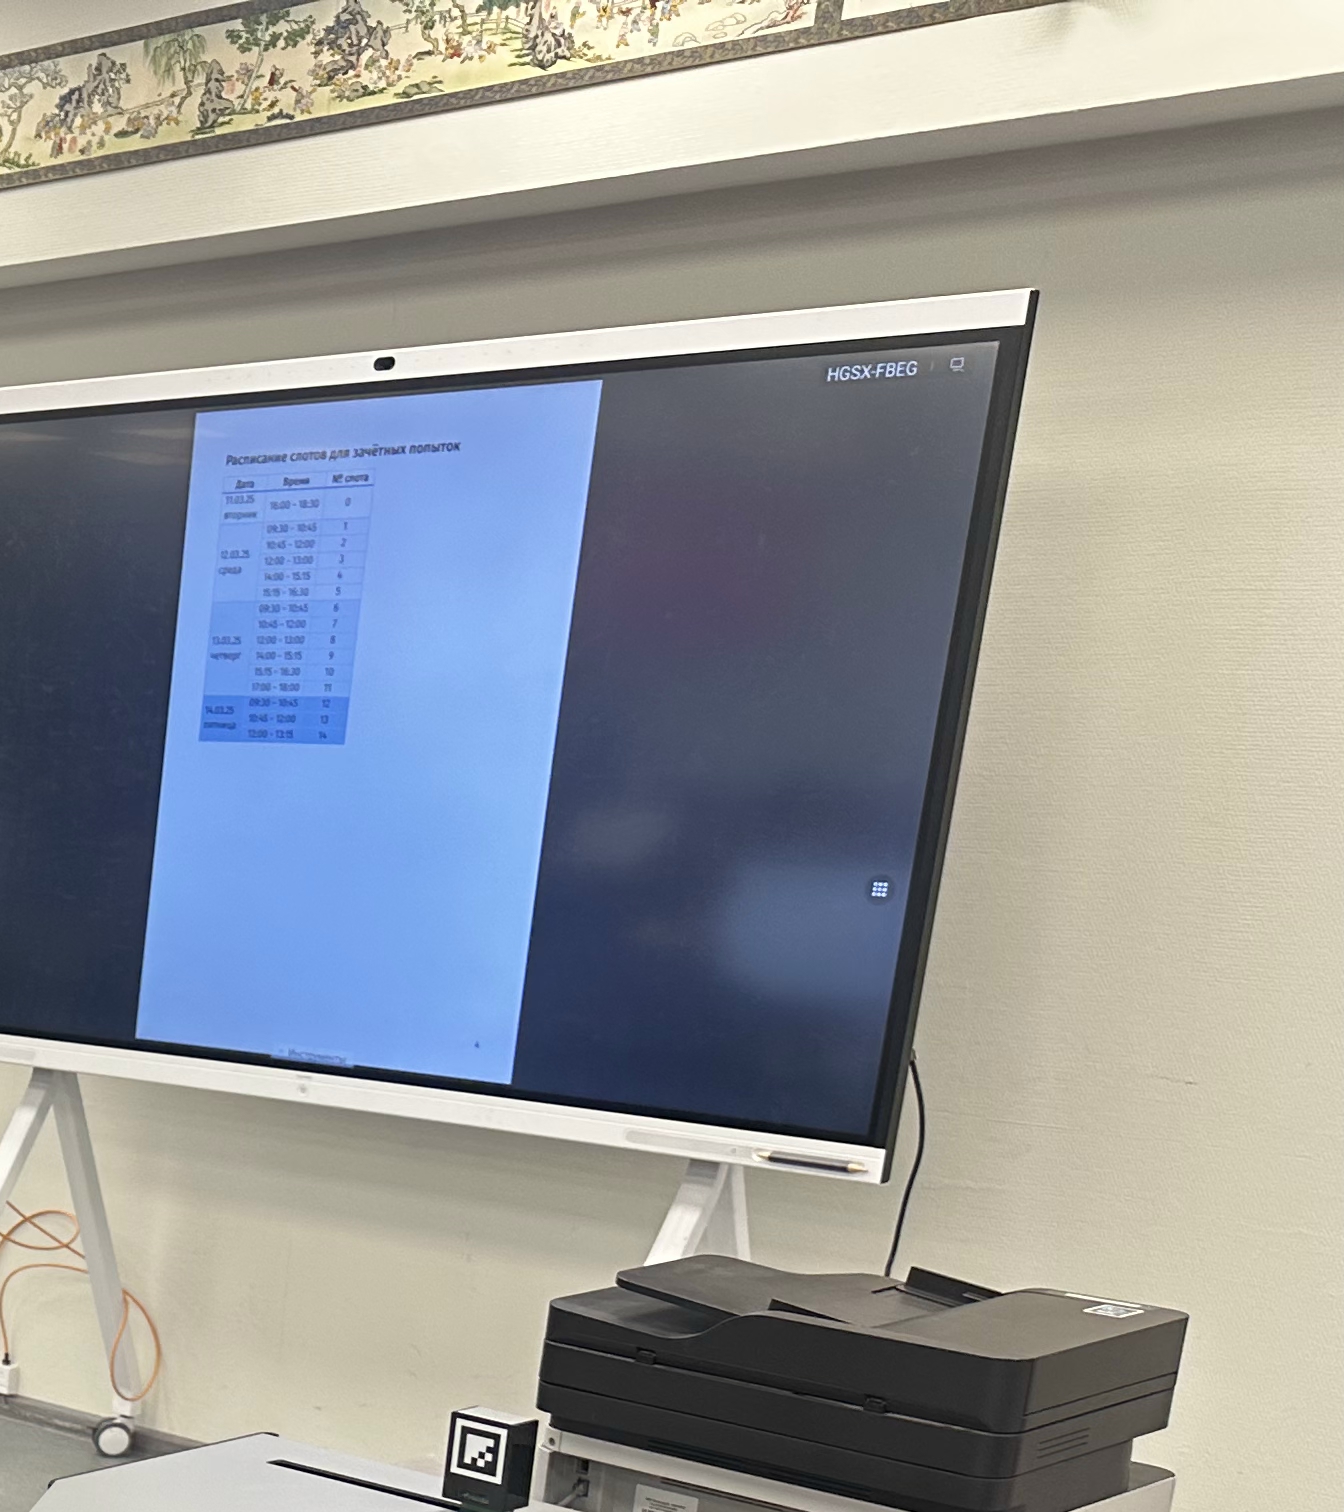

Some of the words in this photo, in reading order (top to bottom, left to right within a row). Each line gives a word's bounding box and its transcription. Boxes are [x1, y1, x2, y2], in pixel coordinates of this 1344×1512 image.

[826, 360, 918, 382] HGSX-FBEG
[225, 453, 288, 466] Расписание
[289, 451, 327, 462] слотов
[329, 449, 350, 461] для
[352, 443, 407, 458] зачётных
[409, 441, 462, 454] попыток
